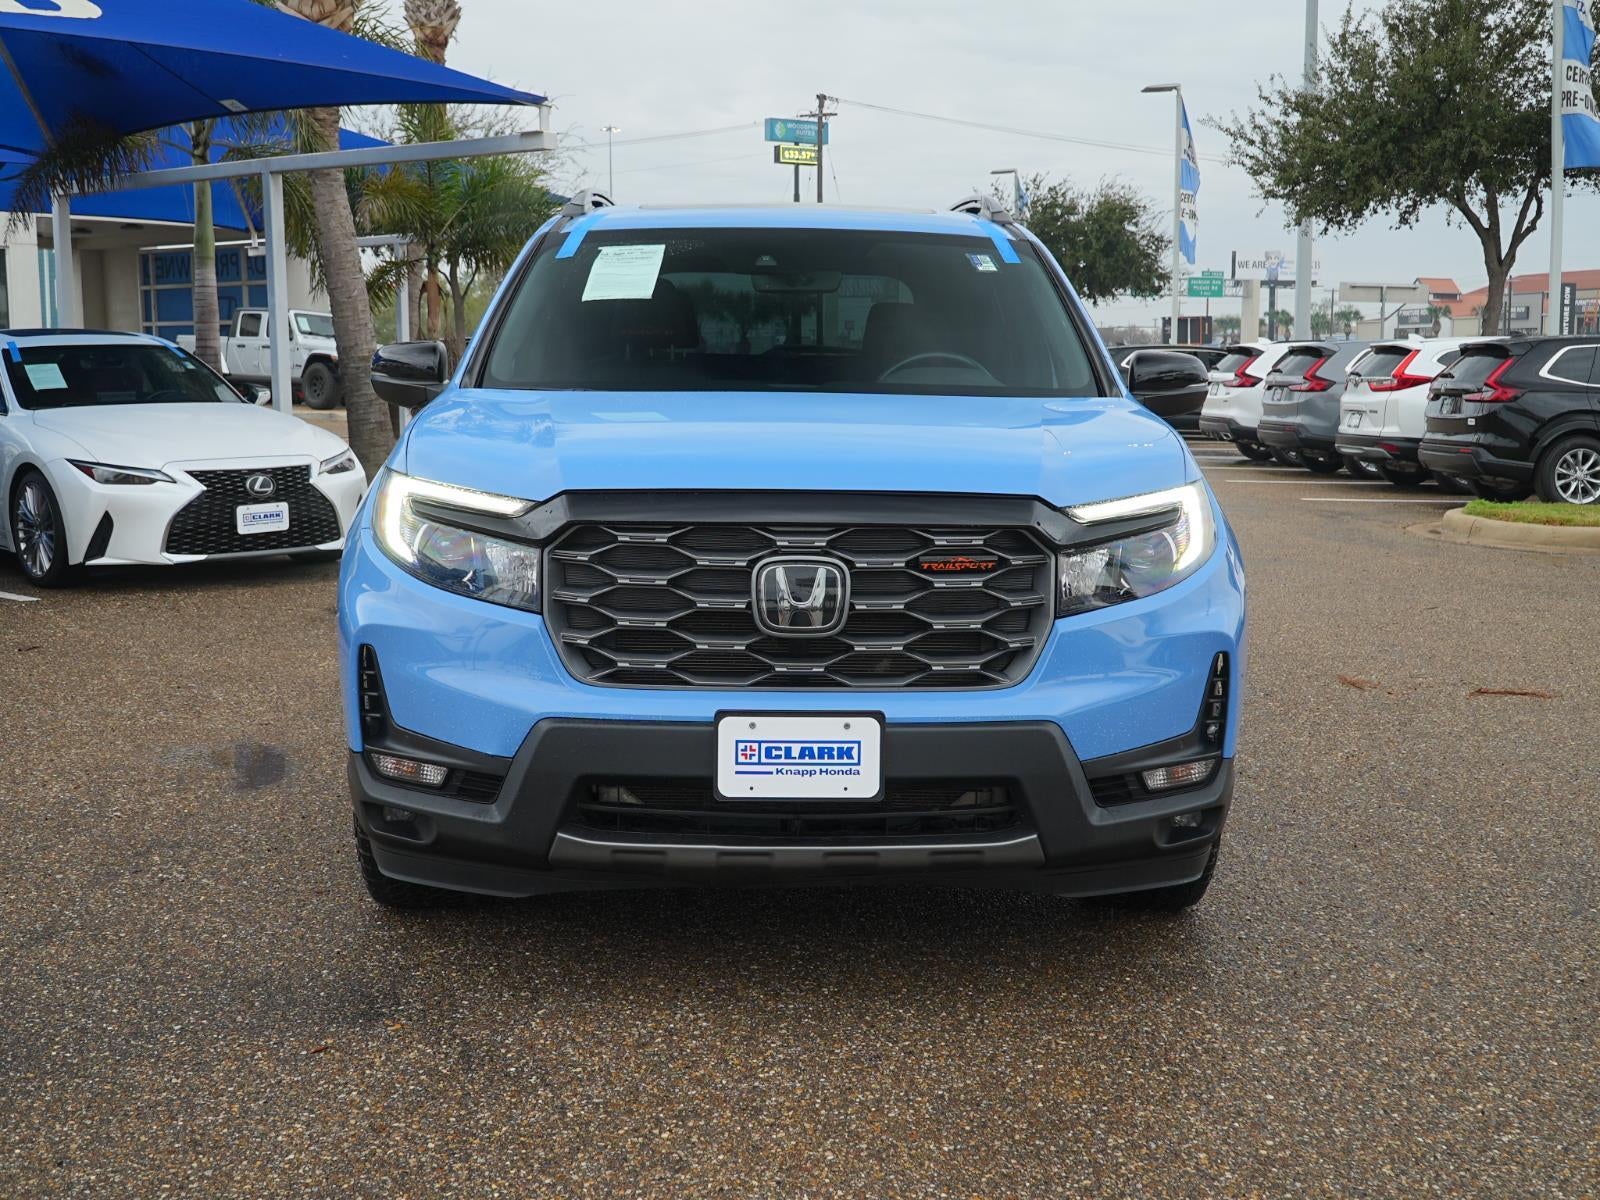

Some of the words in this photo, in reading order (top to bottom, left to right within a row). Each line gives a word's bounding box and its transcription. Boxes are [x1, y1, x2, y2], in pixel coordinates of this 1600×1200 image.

[1237, 260, 1249, 269] WE
[1251, 260, 1268, 269] ARE
[921, 562, 996, 571] TRAILSPORT
[764, 746, 855, 760] CLARK
[775, 767, 817, 777] Knapp
[819, 767, 861, 776] Honda
